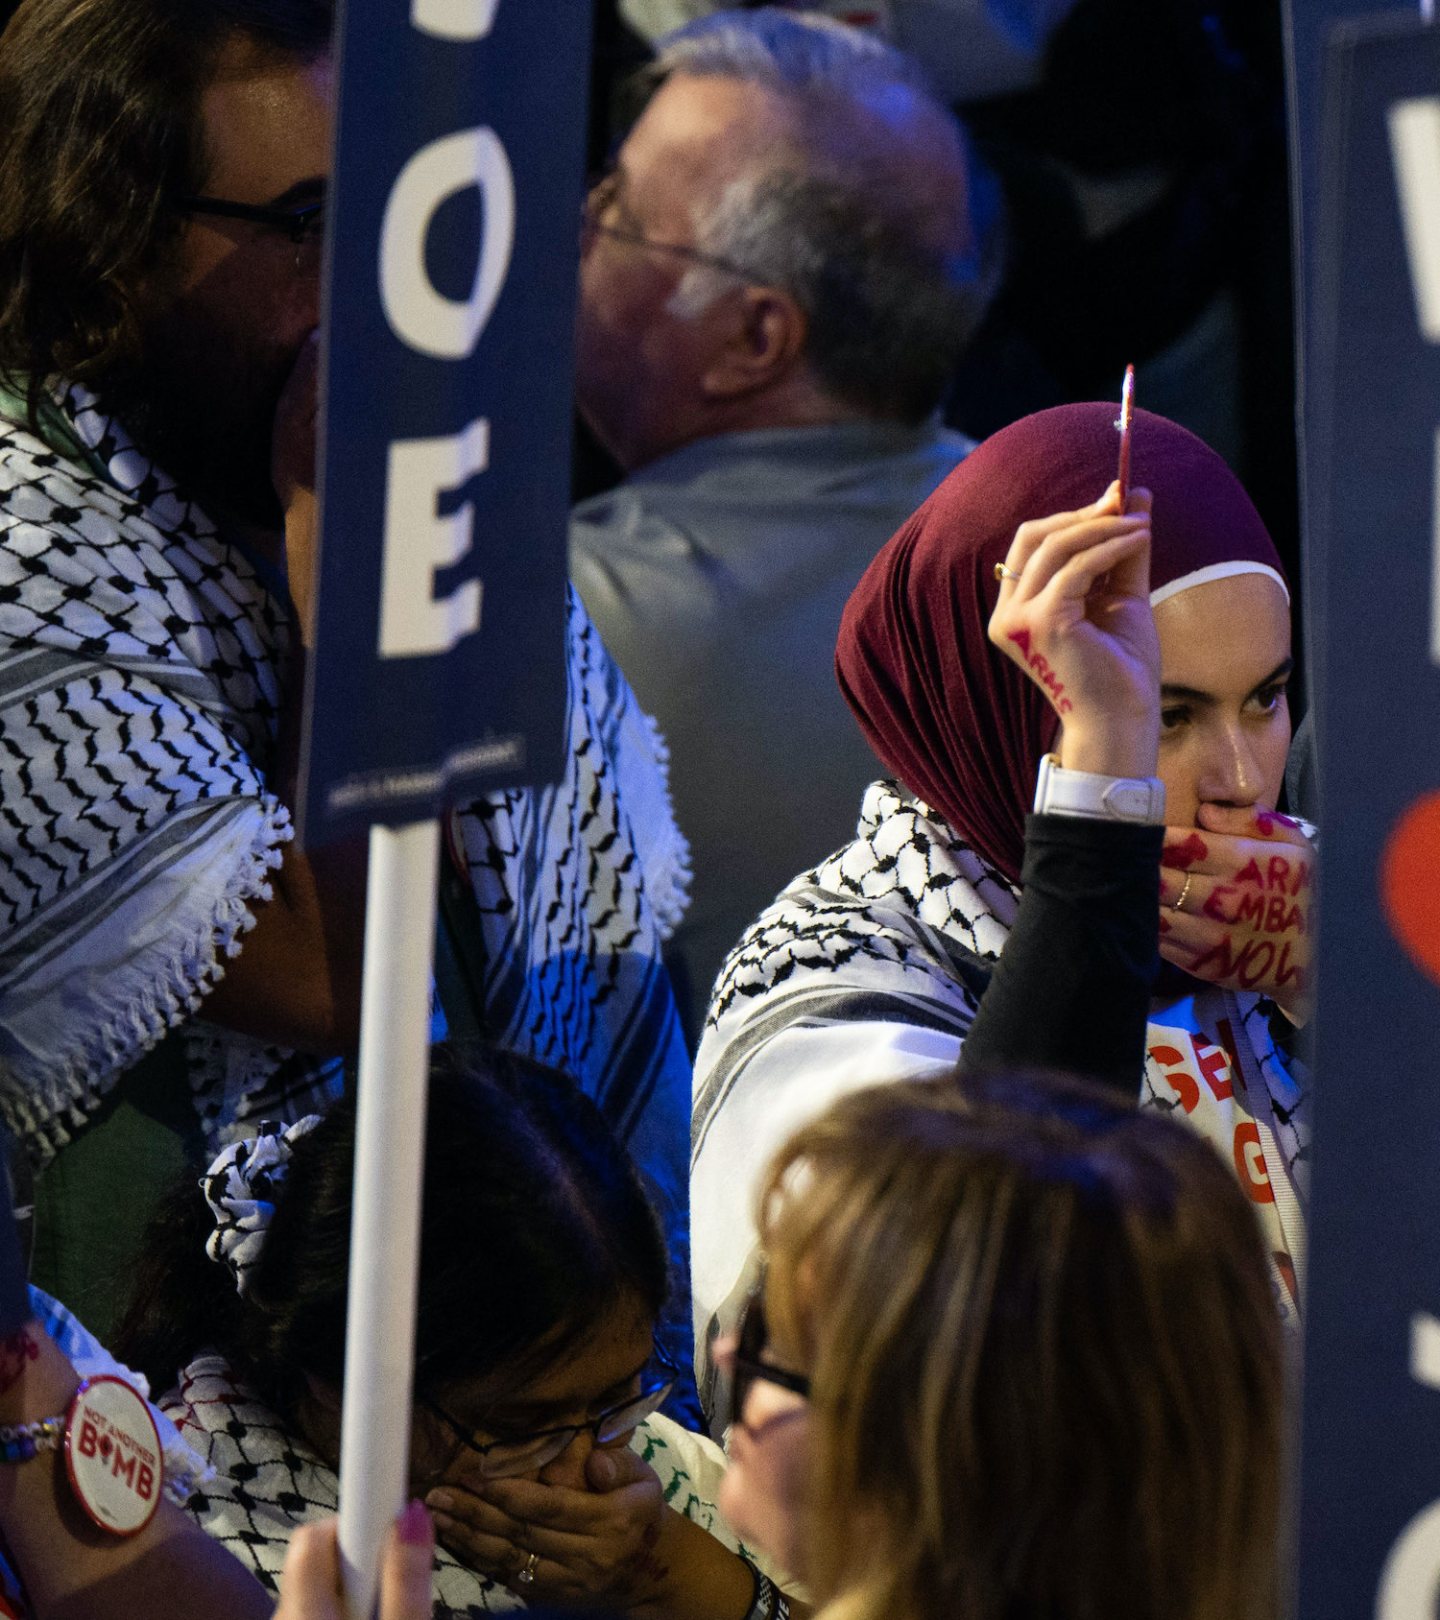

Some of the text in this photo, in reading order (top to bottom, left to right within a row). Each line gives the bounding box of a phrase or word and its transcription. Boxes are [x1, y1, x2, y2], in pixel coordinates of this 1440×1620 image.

[376, 0, 517, 661] OE
[1007, 628, 1073, 715] ARMS
[1203, 885, 1317, 936] EMBA
[84, 1405, 157, 1467] NOT ANOTHER
